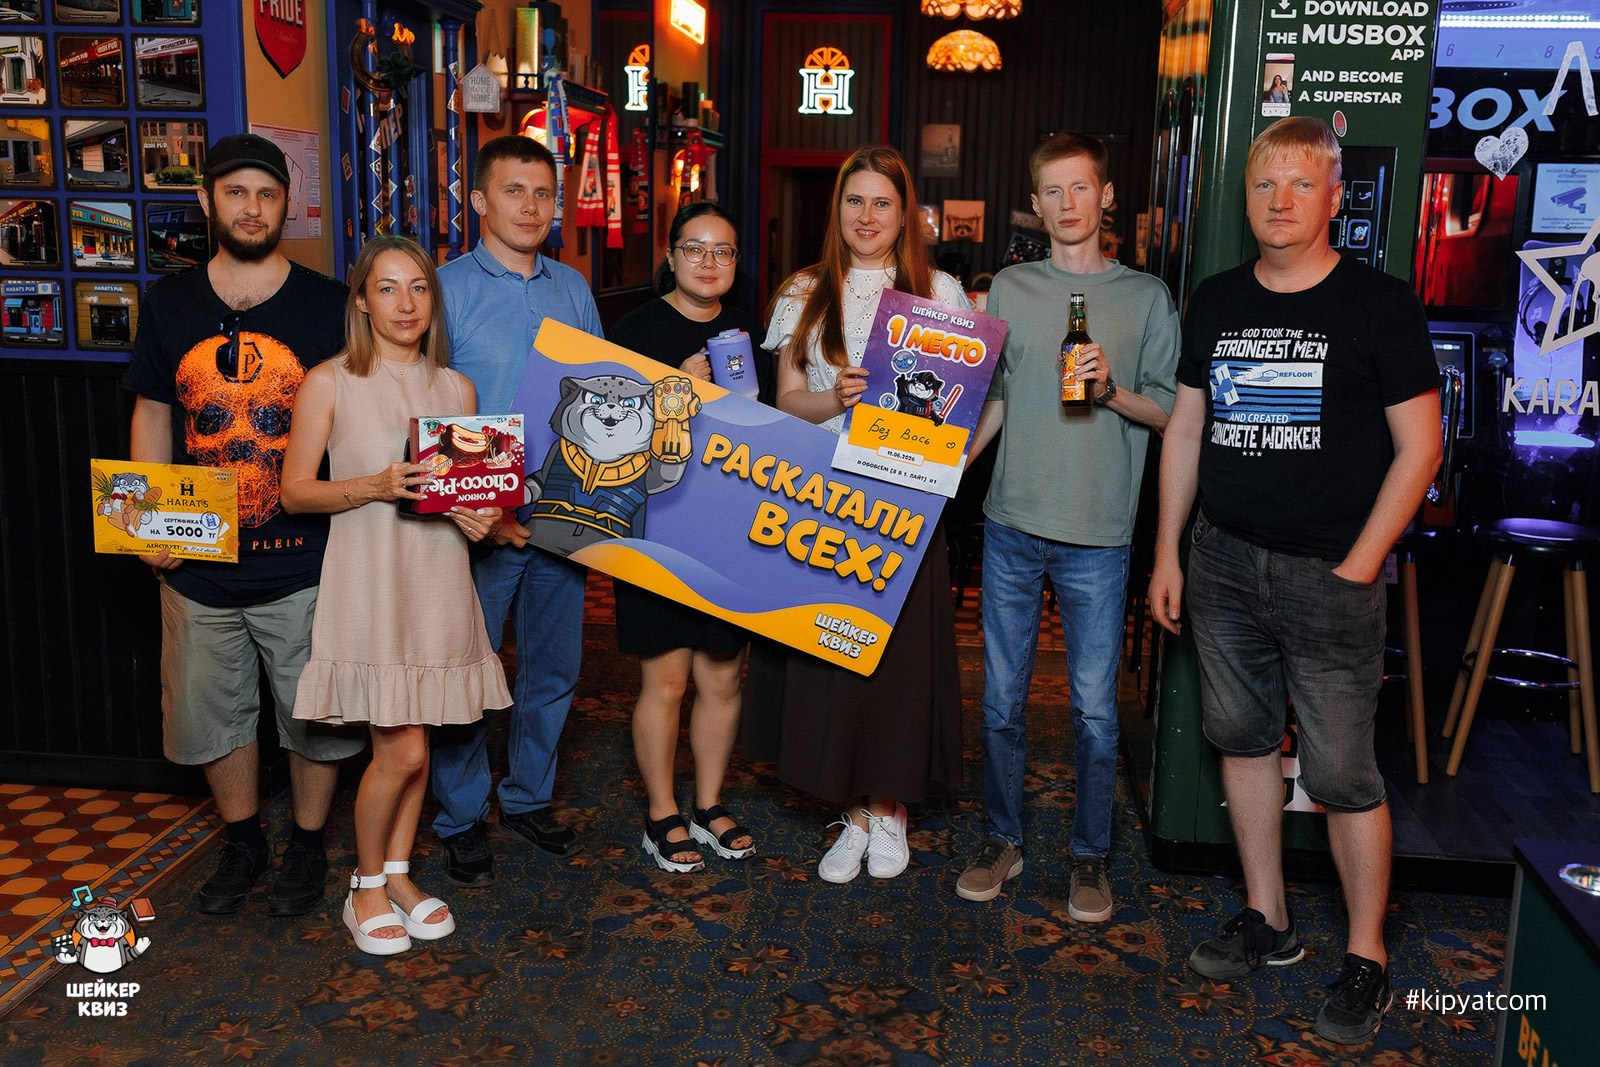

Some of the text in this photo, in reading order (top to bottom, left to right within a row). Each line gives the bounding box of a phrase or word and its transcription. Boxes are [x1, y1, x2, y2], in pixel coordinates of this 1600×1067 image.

[1304, 1, 1429, 17] DOWNLOAD
[1267, 24, 1426, 46] THE MUSBOX
[1390, 49, 1425, 61] APP
[1446, 44, 1455, 56] 6
[1496, 44, 1504, 58] 7
[1544, 45, 1554, 58] 8
[470, 76, 491, 86] HOME
[1300, 70, 1404, 84] AND BECOME
[470, 94, 492, 102] HOME
[1298, 91, 1402, 104] A SUPERSTAR
[912, 305, 976, 330] ШЕЙКЕР КВИЗ
[1242, 328, 1304, 338] GOD TOOK THE
[888, 315, 985, 366] 1 МЕСТО
[1212, 340, 1328, 360] STRONGEST MEN
[1228, 413, 1289, 424] AND CREATED
[868, 418, 930, 446] Без Вось
[1261, 426, 1321, 450] WORKER
[887, 450, 915, 462] 11.06.2026
[701, 432, 925, 546] РАСКАТАЛИ
[167, 498, 209, 508] HARAT'S
[166, 526, 203, 538] 5000
[252, 537, 304, 550] PLEIN
[748, 501, 904, 592] ВСЕХ!
[814, 612, 879, 646] ШЕЙКЕР
[818, 631, 862, 658] КВИЗ
